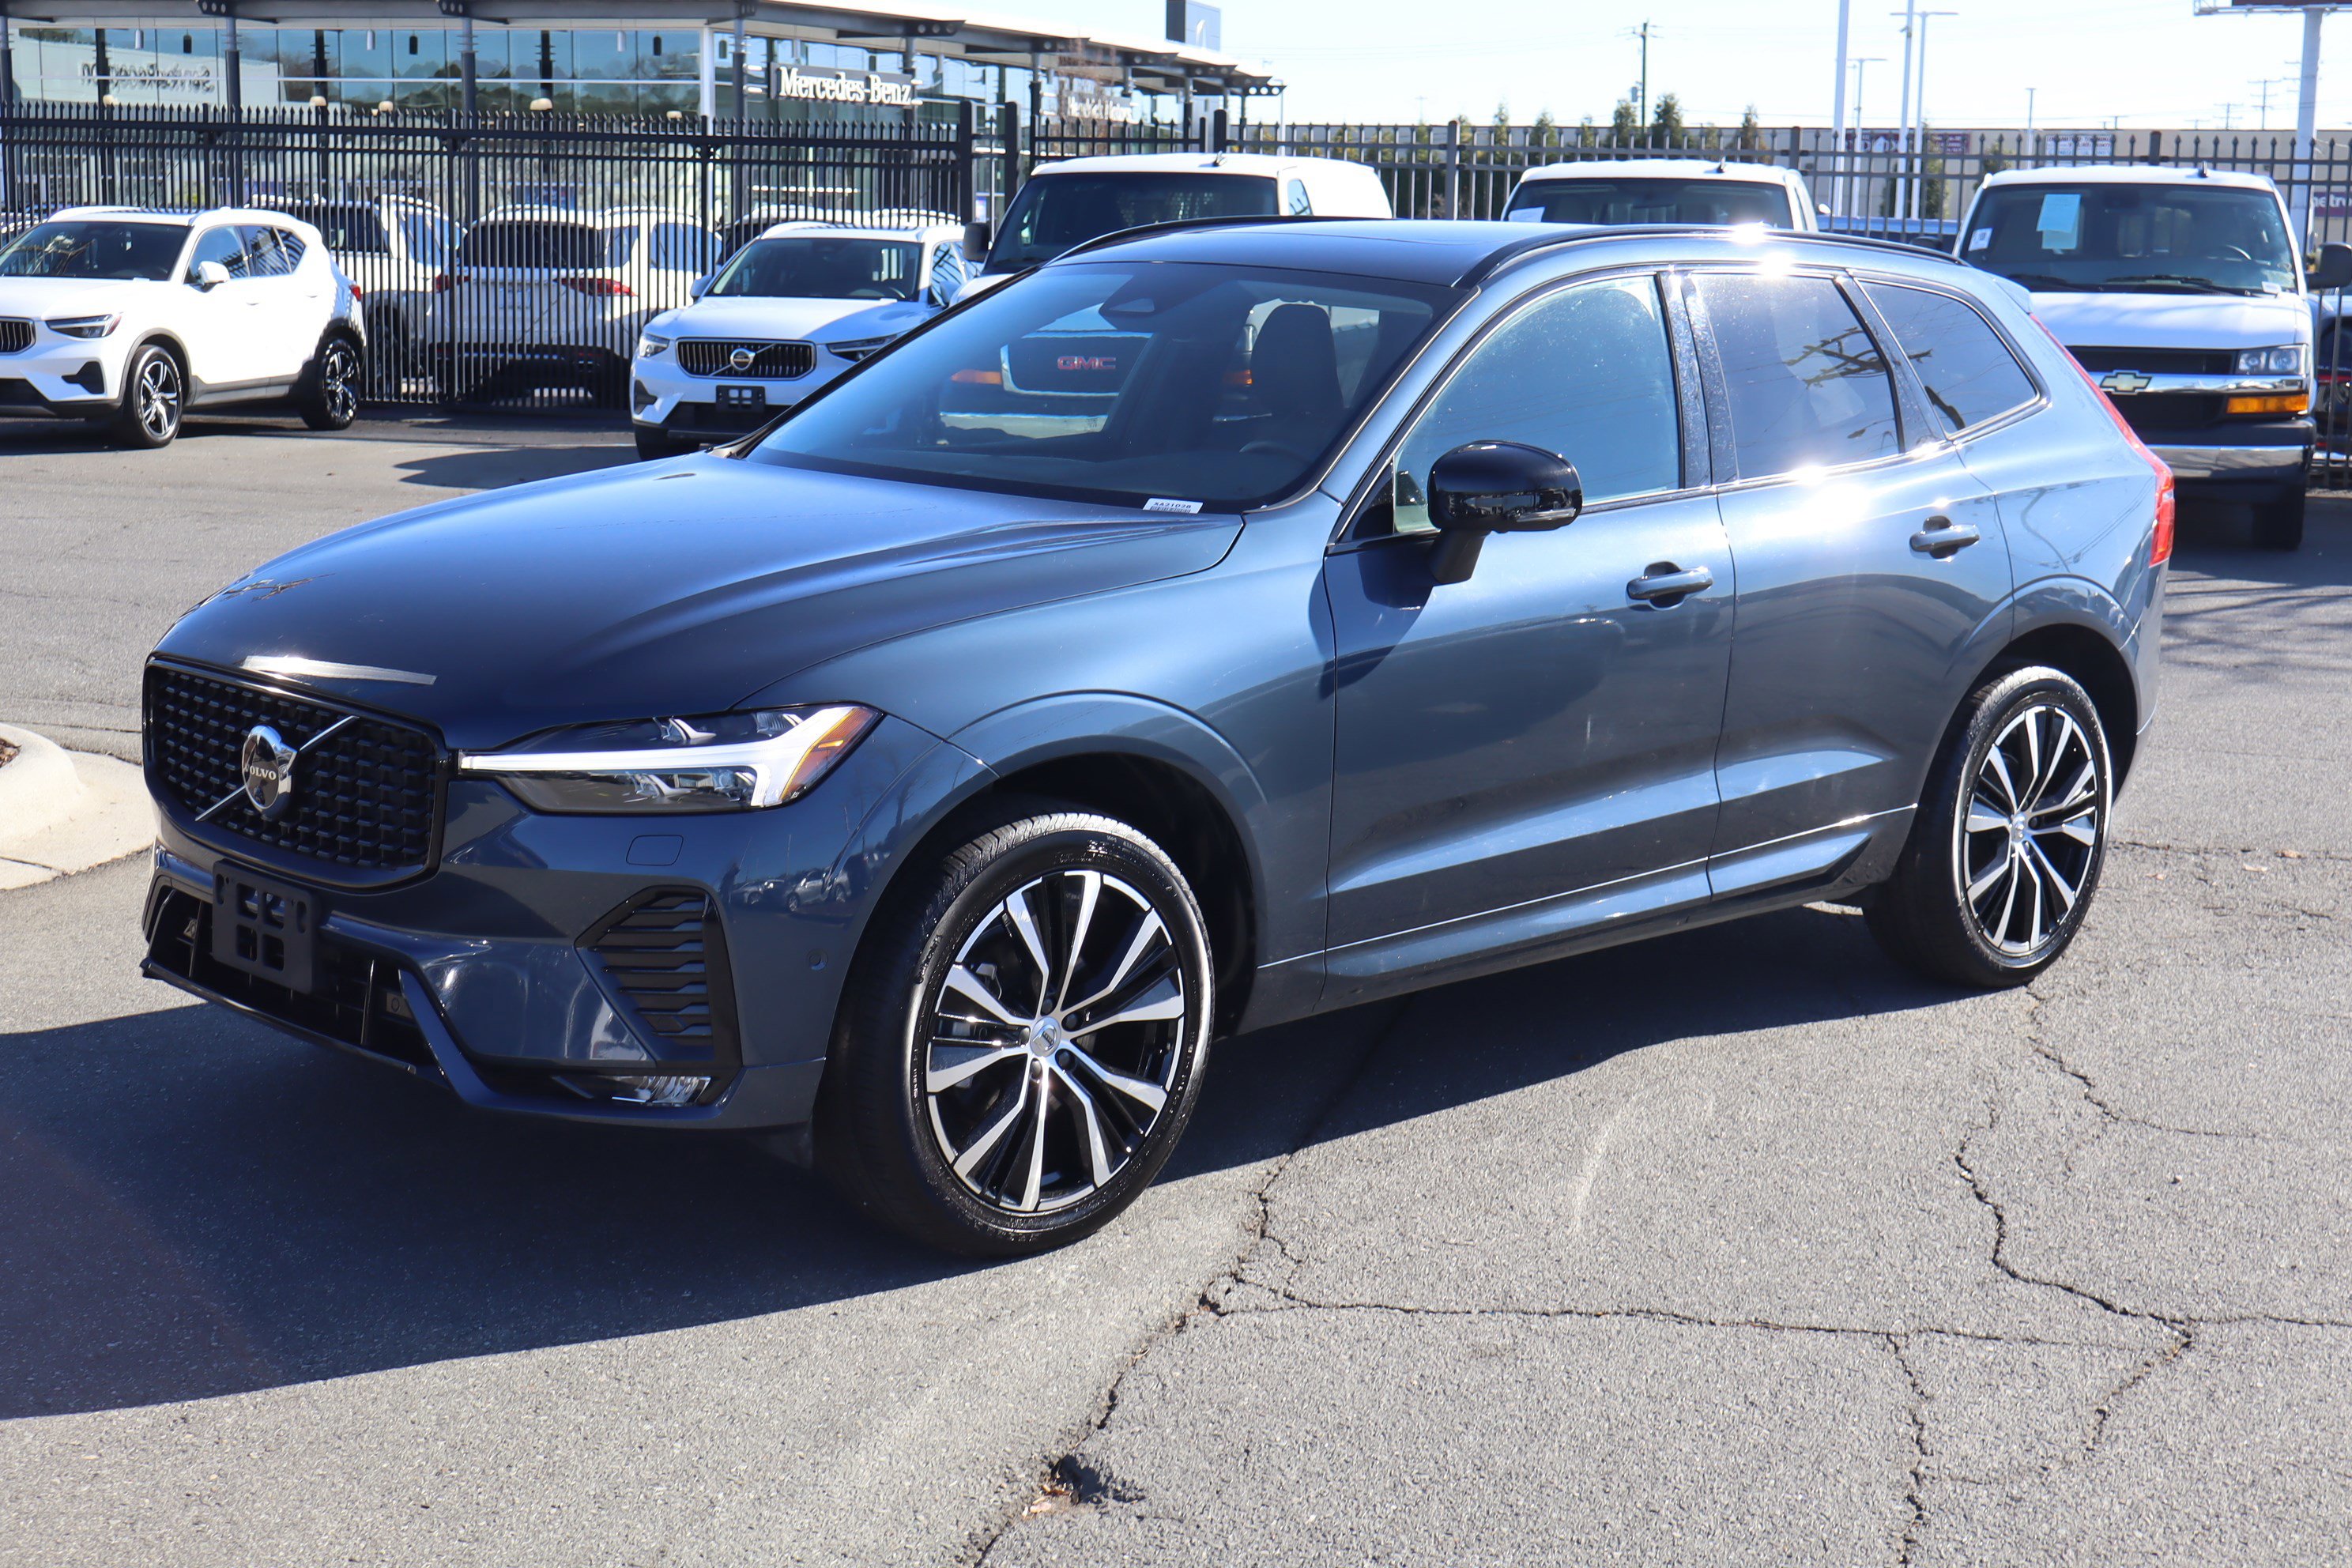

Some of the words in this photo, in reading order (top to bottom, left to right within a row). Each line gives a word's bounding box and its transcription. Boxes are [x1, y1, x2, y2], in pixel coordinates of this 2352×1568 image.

[778, 66, 912, 105] Mercedes-Benz
[1057, 356, 1116, 370] GMC
[244, 764, 277, 780] VOLVO
